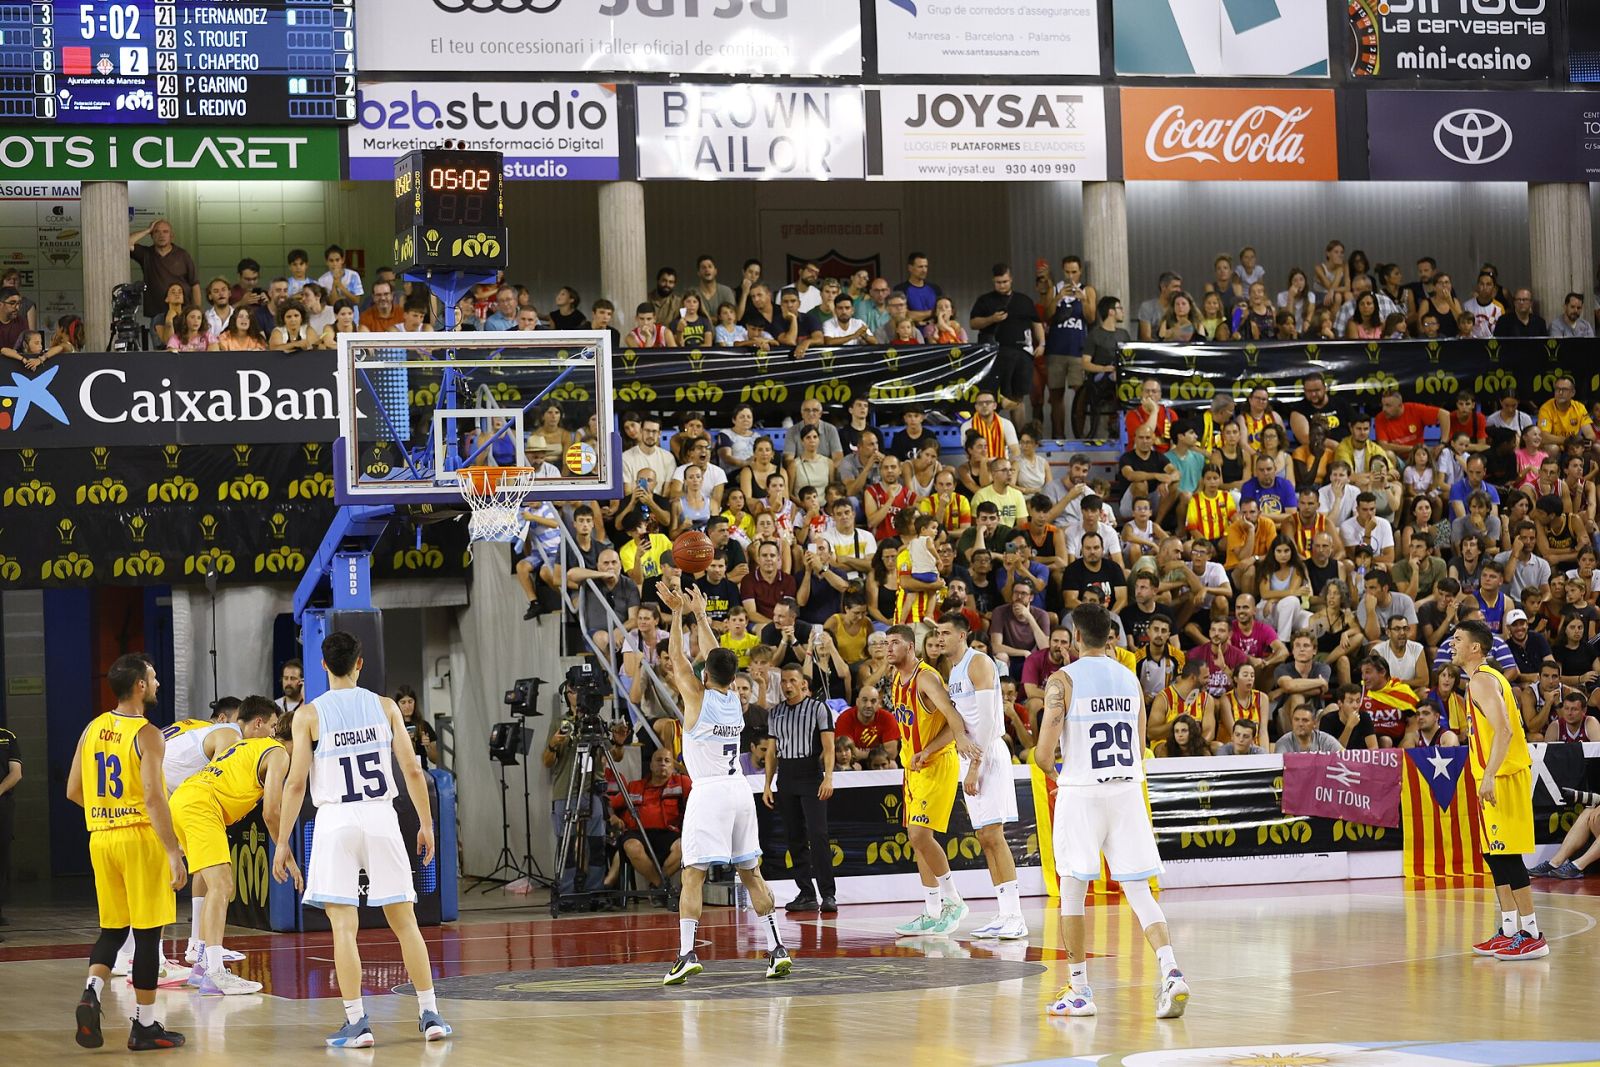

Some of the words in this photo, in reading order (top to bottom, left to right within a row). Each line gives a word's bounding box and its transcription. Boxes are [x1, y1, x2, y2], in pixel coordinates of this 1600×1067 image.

[42, 5, 50, 24] 3
[159, 7, 173, 25] 21
[183, 8, 192, 25] J.
[195, 8, 267, 25] FERNANDEZ
[344, 8, 353, 28] 7
[928, 5, 951, 17] Grup
[954, 6, 967, 16] de
[969, 6, 1015, 16] corredors
[1017, 7, 1091, 18] d'assegurances
[80, 5, 141, 40] 5:02
[1382, 17, 1411, 33] La
[1417, 17, 1546, 35] cerveseria
[42, 28, 51, 47] 3
[158, 30, 174, 48] 23
[184, 31, 196, 48] S.
[198, 31, 247, 47] TROUET
[344, 31, 353, 50] 0
[431, 38, 443, 54] El
[450, 40, 474, 54] teu
[480, 38, 585, 55] concessionari
[599, 38, 637, 55] taller
[644, 40, 689, 56] oficial
[695, 40, 713, 56] de
[908, 32, 951, 41] Manresa
[965, 32, 1014, 42] Barcelona
[1028, 32, 1071, 42] Palamós
[43, 51, 52, 70] 8
[130, 50, 139, 72] 2
[159, 53, 176, 71] 25
[184, 54, 196, 70] T.
[198, 54, 259, 71] CHAPERO
[344, 53, 354, 73] 4
[942, 49, 1040, 57] www.santasusana.com
[1397, 45, 1532, 70] mini-casino
[43, 74, 53, 94] 0
[67, 77, 105, 86] Ajuntament
[106, 77, 115, 85] de
[160, 75, 176, 94] 29
[185, 77, 196, 93] P.
[198, 77, 248, 94] GARINO
[344, 77, 354, 96] 2
[44, 97, 54, 117] 0
[160, 98, 178, 117] 30
[199, 100, 247, 116] REDIVO
[345, 98, 356, 118] 6
[357, 89, 607, 130] b2b.studio
[663, 91, 830, 129] BROWN
[904, 93, 1084, 128] JOYSAT
[1145, 105, 1312, 163] Coca-Cola
[0, 136, 95, 168] OTS
[109, 136, 117, 167] i
[132, 137, 307, 169] CLARET
[363, 137, 437, 151] Marketing
[558, 138, 604, 152] Digital
[665, 135, 831, 173] TAILOR
[904, 142, 947, 151] LLOGUER
[950, 142, 1021, 151] PLATAFORMES
[1023, 142, 1086, 151] ELEVADORES
[430, 168, 490, 190] 05:02
[503, 161, 568, 178] studio
[918, 164, 995, 175] www.joysat.eu
[1006, 164, 1027, 174] 930
[1030, 164, 1051, 174] 409
[1055, 164, 1076, 174] 990
[79, 369, 367, 424] CaixaBank
[349, 557, 358, 595] MONDO
[1090, 698, 1131, 713] GARINO
[1089, 722, 1135, 769] 29
[723, 743, 738, 775] 7
[95, 751, 124, 799] 13
[339, 752, 388, 802] 15
[1315, 786, 1333, 803] ON
[1337, 789, 1370, 810] TOUR
